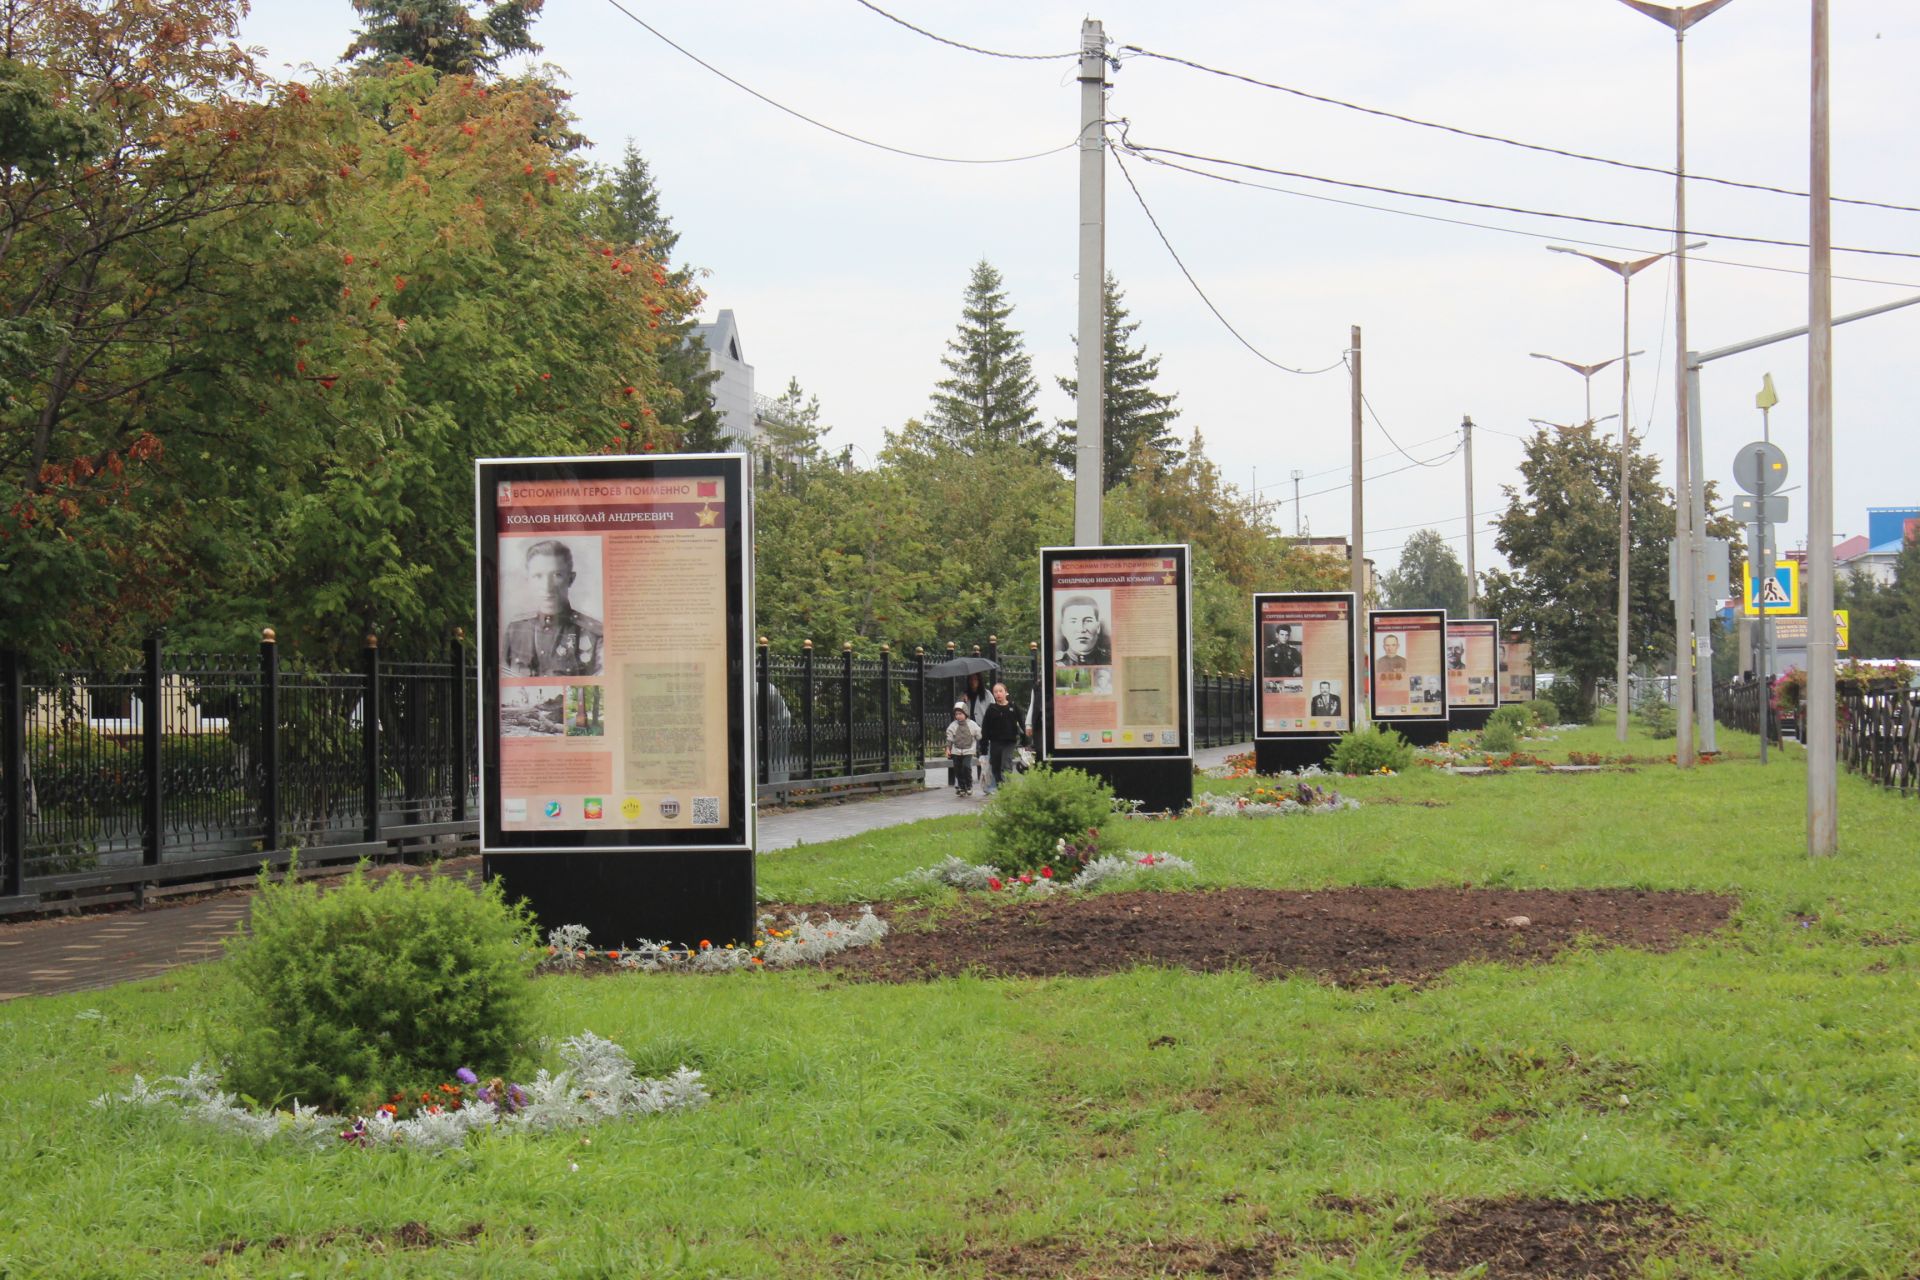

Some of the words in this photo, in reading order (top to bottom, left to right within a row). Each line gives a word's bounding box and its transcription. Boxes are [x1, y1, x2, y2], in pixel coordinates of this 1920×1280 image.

[513, 488, 580, 499] ВСПОМНИМ
[583, 487, 622, 497] ГЕРОЕВ
[625, 485, 690, 496] ПОИМЕННО
[506, 514, 551, 524] КОЗЛОВ
[554, 511, 605, 523] НИКОЛАЙ
[608, 511, 674, 523] АНДРЕЕВИЧ
[1096, 575, 1125, 584] НИКОЛАЙ
